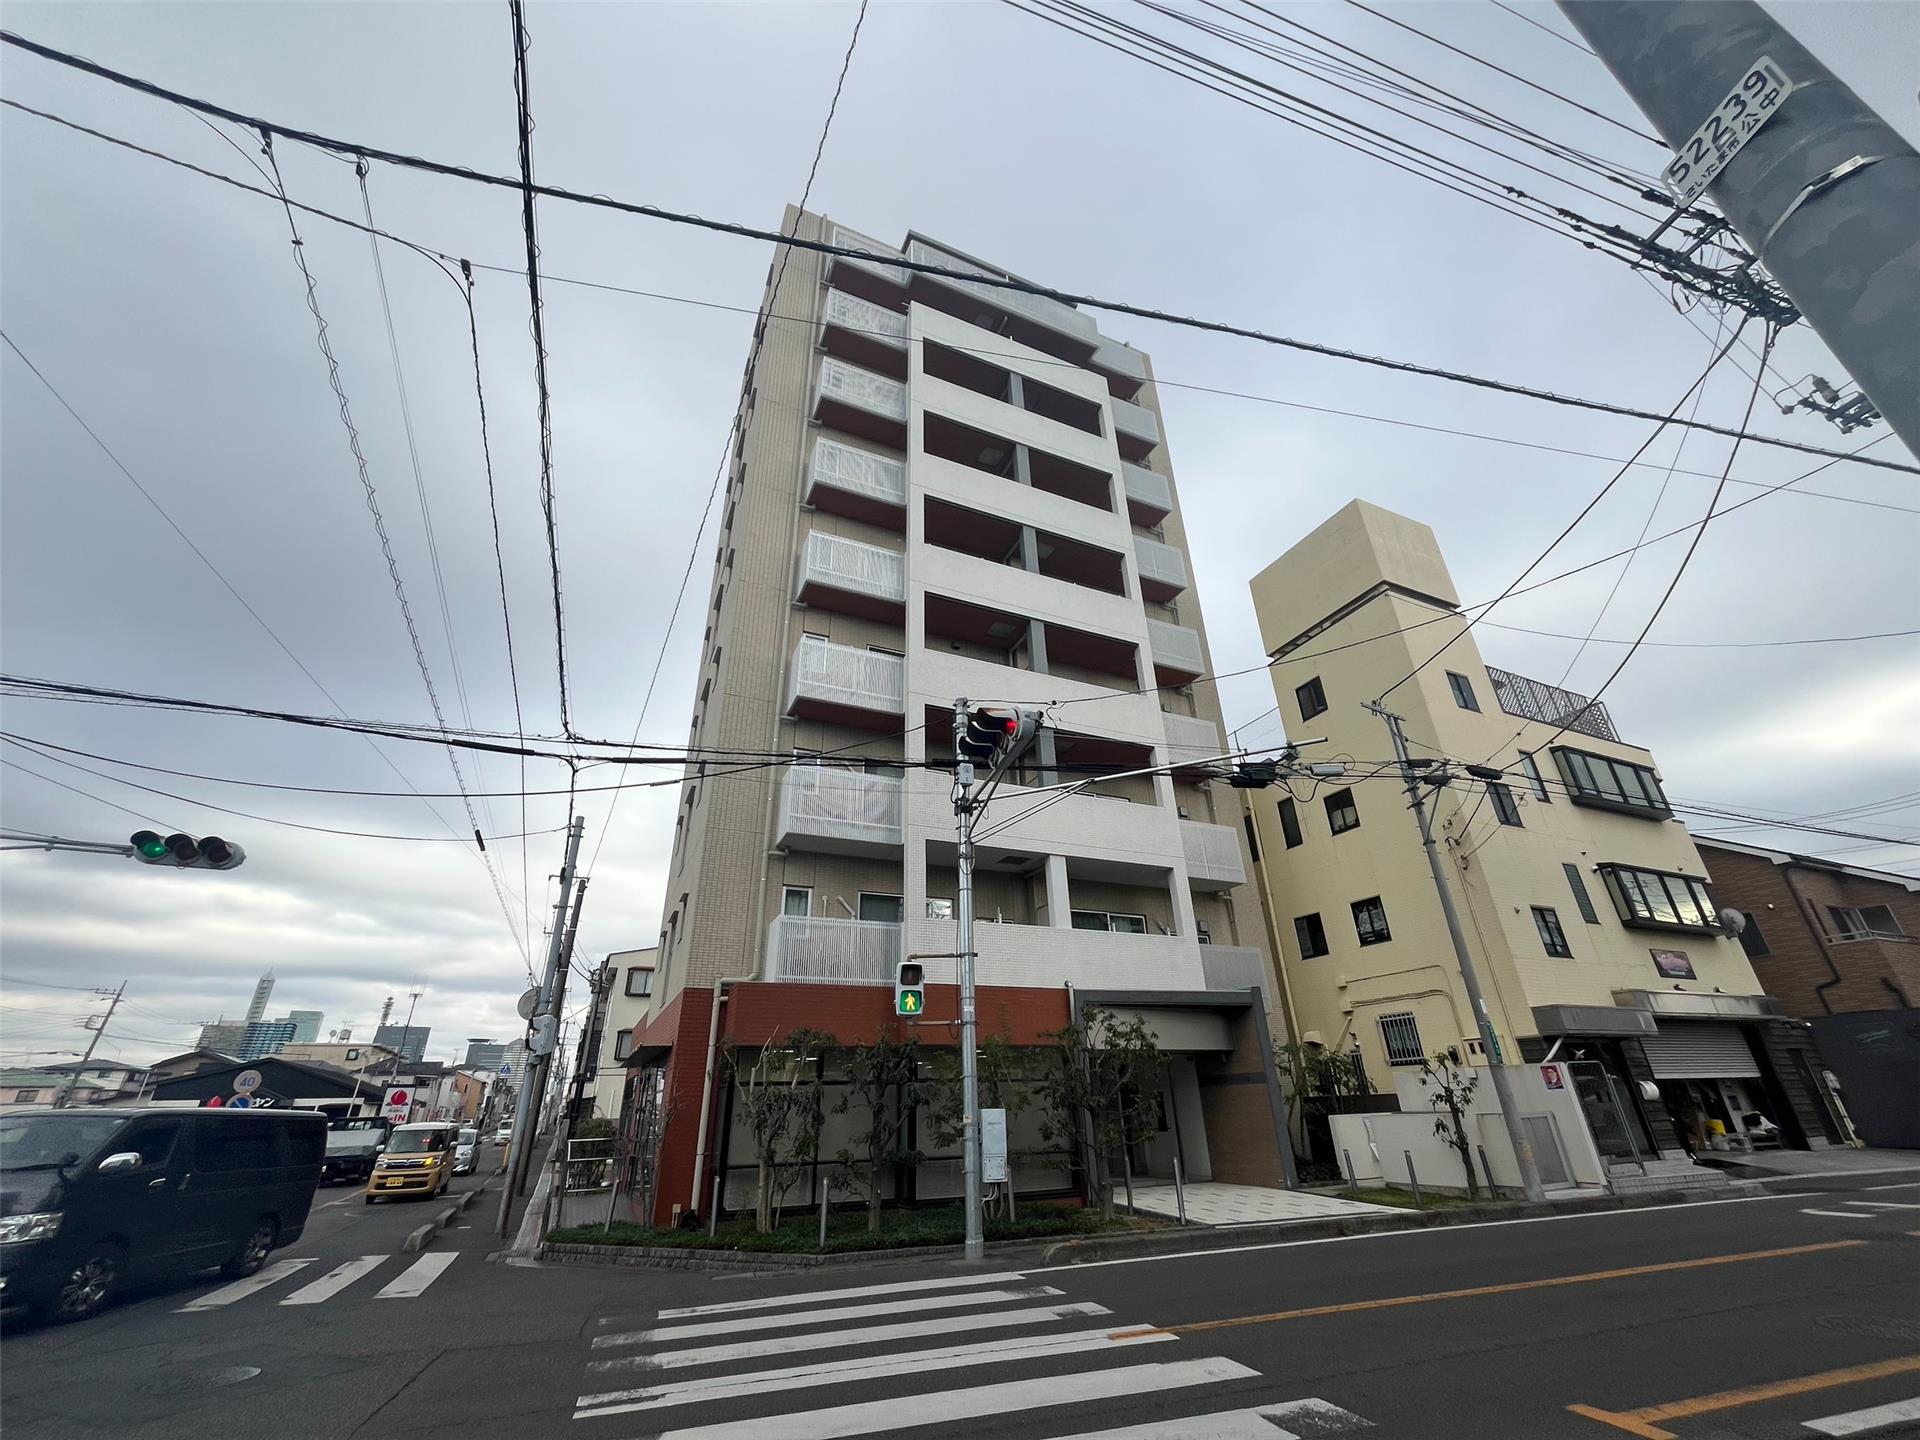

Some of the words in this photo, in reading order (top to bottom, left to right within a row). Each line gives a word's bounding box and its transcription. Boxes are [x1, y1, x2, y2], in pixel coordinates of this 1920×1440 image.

[1668, 70, 1768, 184] 52239
[240, 1076, 256, 1087] 40
[253, 1097, 276, 1107] ヤン
[393, 1113, 406, 1122] IN
